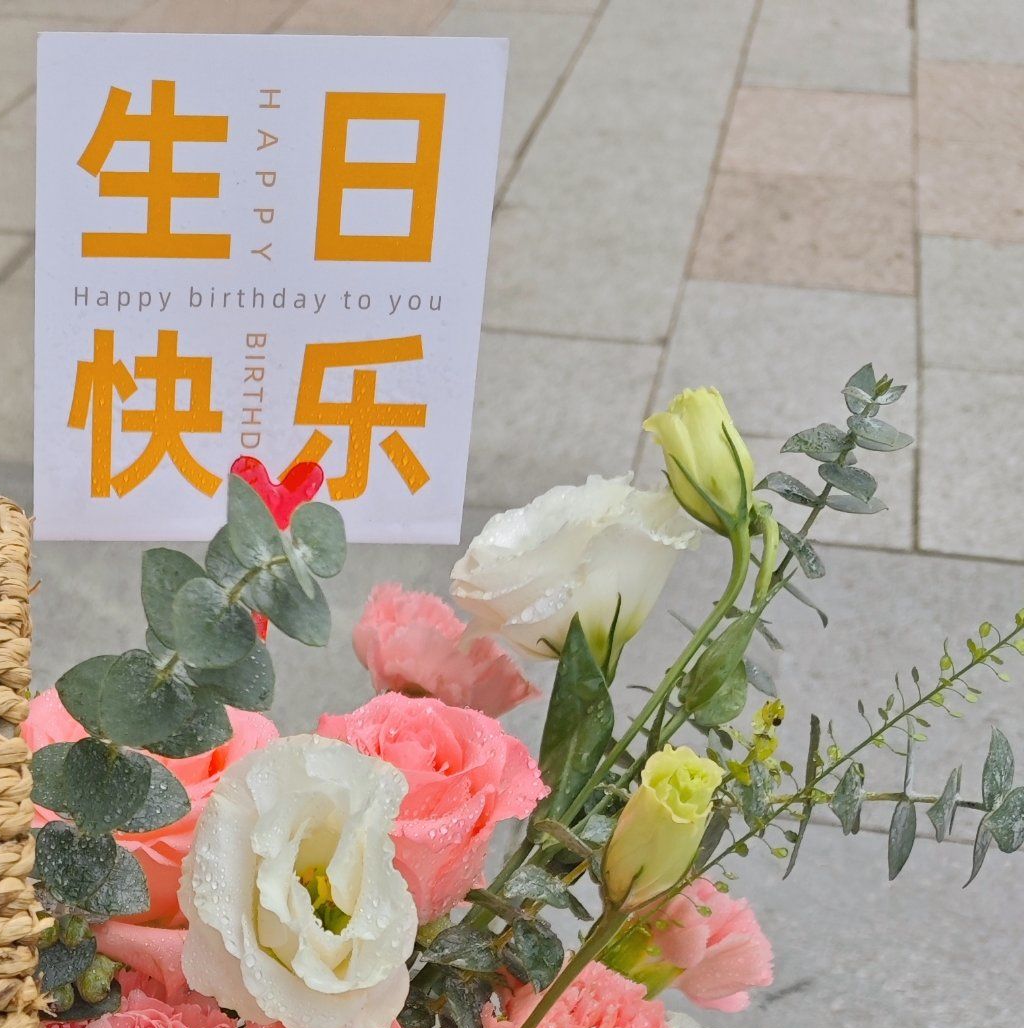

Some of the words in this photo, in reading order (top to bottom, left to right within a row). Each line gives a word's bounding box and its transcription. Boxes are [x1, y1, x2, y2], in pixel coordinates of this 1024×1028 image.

[250, 88, 282, 262] HAPPY
[73, 286, 172, 313] Happy
[189, 286, 327, 315] birthday
[342, 290, 372, 311] to
[388, 294, 443, 316] you
[240, 332, 268, 450] BIRTHD
